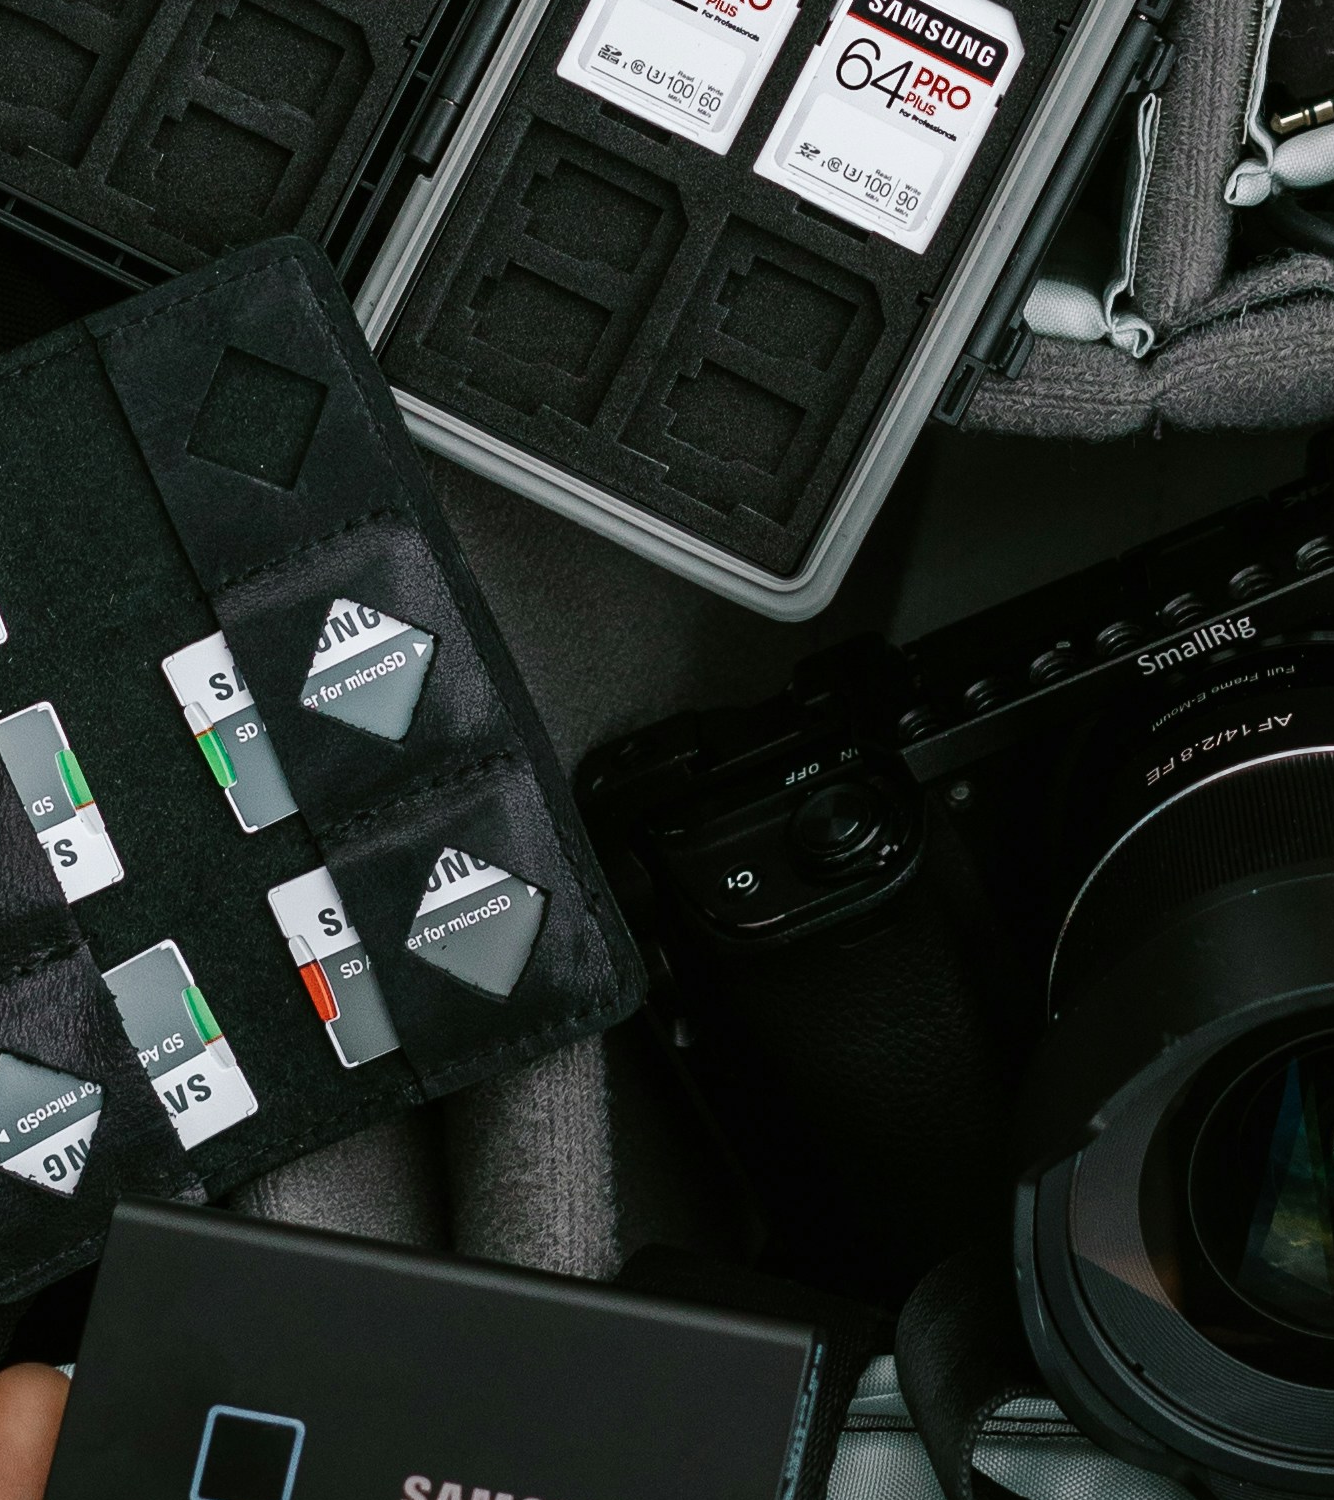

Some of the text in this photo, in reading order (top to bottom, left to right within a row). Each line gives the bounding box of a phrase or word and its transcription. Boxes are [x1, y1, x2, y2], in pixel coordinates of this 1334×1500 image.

[702, 9, 759, 42] For Professionals
[836, 38, 971, 110] 64 PRO
[667, 76, 694, 98] 100
[699, 92, 721, 112] 60
[904, 91, 936, 117] Plus
[899, 109, 956, 142] For Professionals
[865, 174, 892, 198] 100
[895, 190, 918, 211] 90
[1137, 617, 1256, 675] SmallRig
[320, 683, 343, 702] for
[345, 651, 406, 691] microSD
[1152, 665, 1295, 732] Full Frame E-Mount
[236, 723, 258, 743] SD
[1145, 713, 1293, 786] AF 14/2.8 FE
[785, 762, 820, 785] OFF
[32, 796, 54, 816] SD
[727, 870, 753, 889] C1
[424, 924, 446, 943] for
[448, 895, 510, 932] microSD
[340, 959, 363, 979] SD
[163, 1033, 184, 1054] SD
[17, 1082, 102, 1133] for microSD
